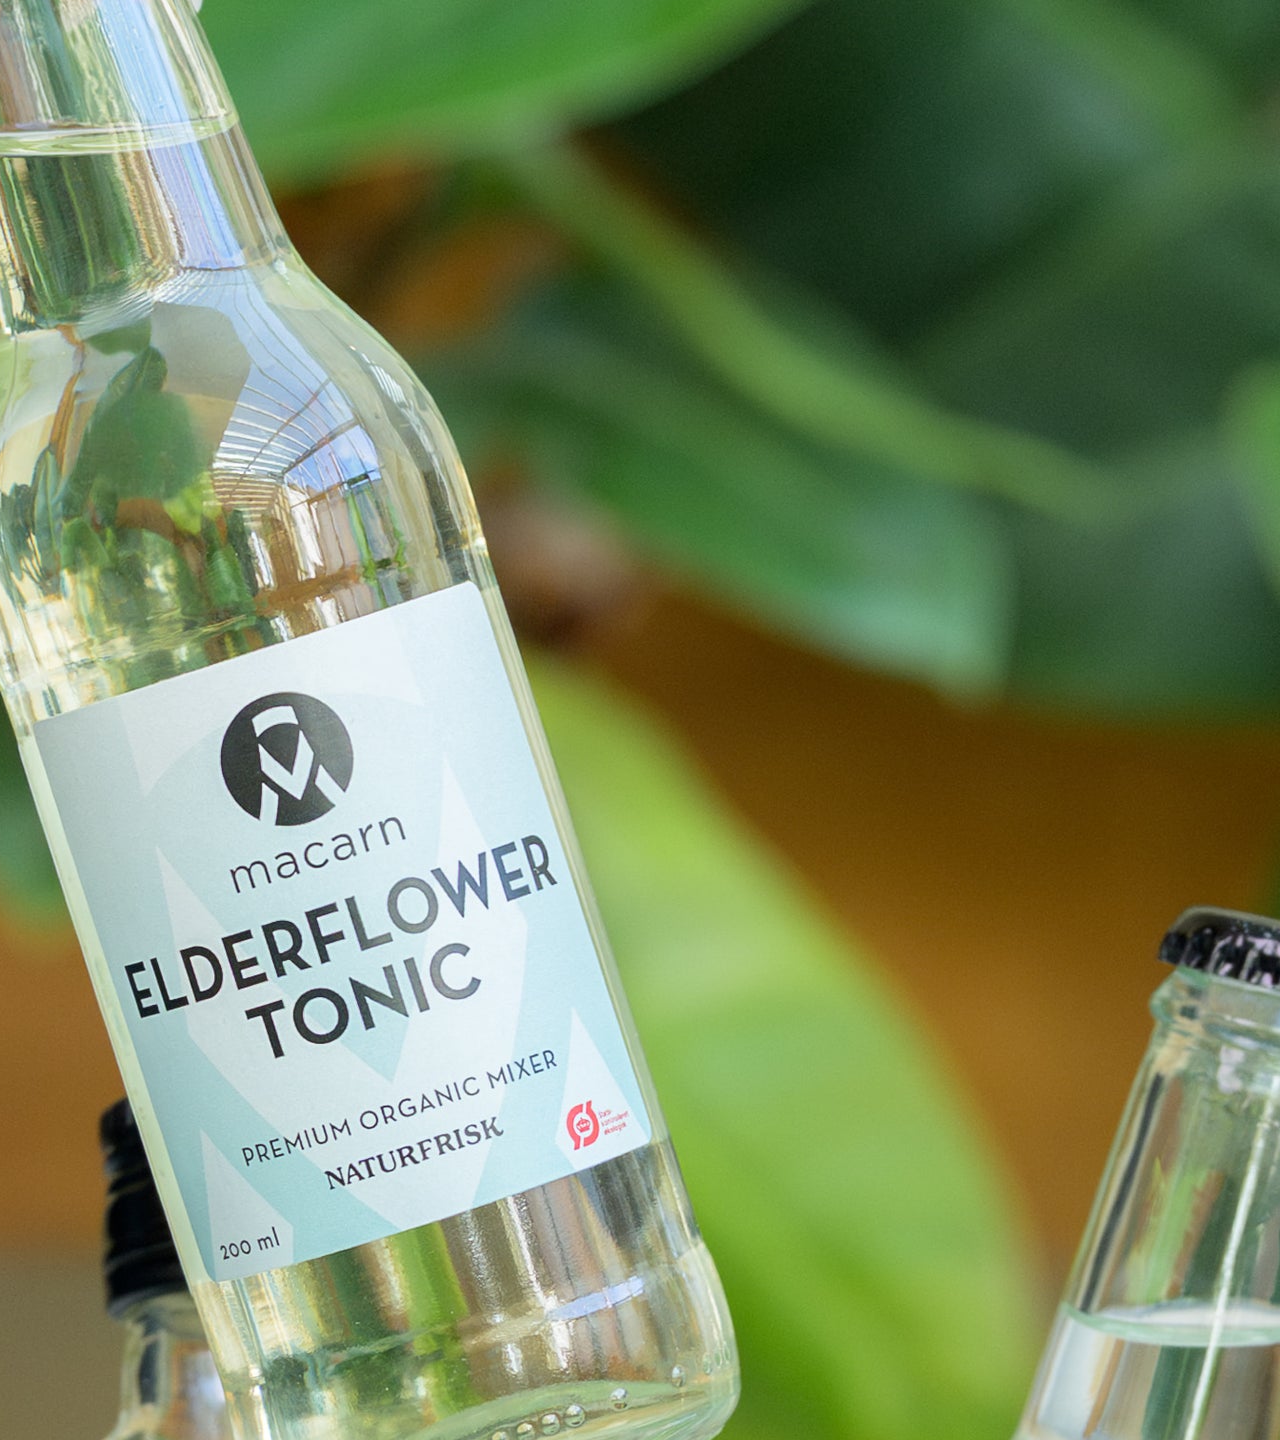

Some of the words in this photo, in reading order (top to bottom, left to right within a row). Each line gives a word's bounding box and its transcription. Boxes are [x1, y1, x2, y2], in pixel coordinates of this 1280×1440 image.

[229, 815, 407, 894] macarn
[124, 833, 558, 1019] ELDERFLOWER
[246, 943, 483, 1060] TONIC
[241, 1118, 352, 1167] PREMIUM
[359, 1076, 481, 1131] ORGANIC
[486, 1049, 557, 1090] MIXER
[324, 1116, 505, 1190] NATURFRISK
[220, 1240, 251, 1260] 200
[257, 1226, 280, 1251] ml
